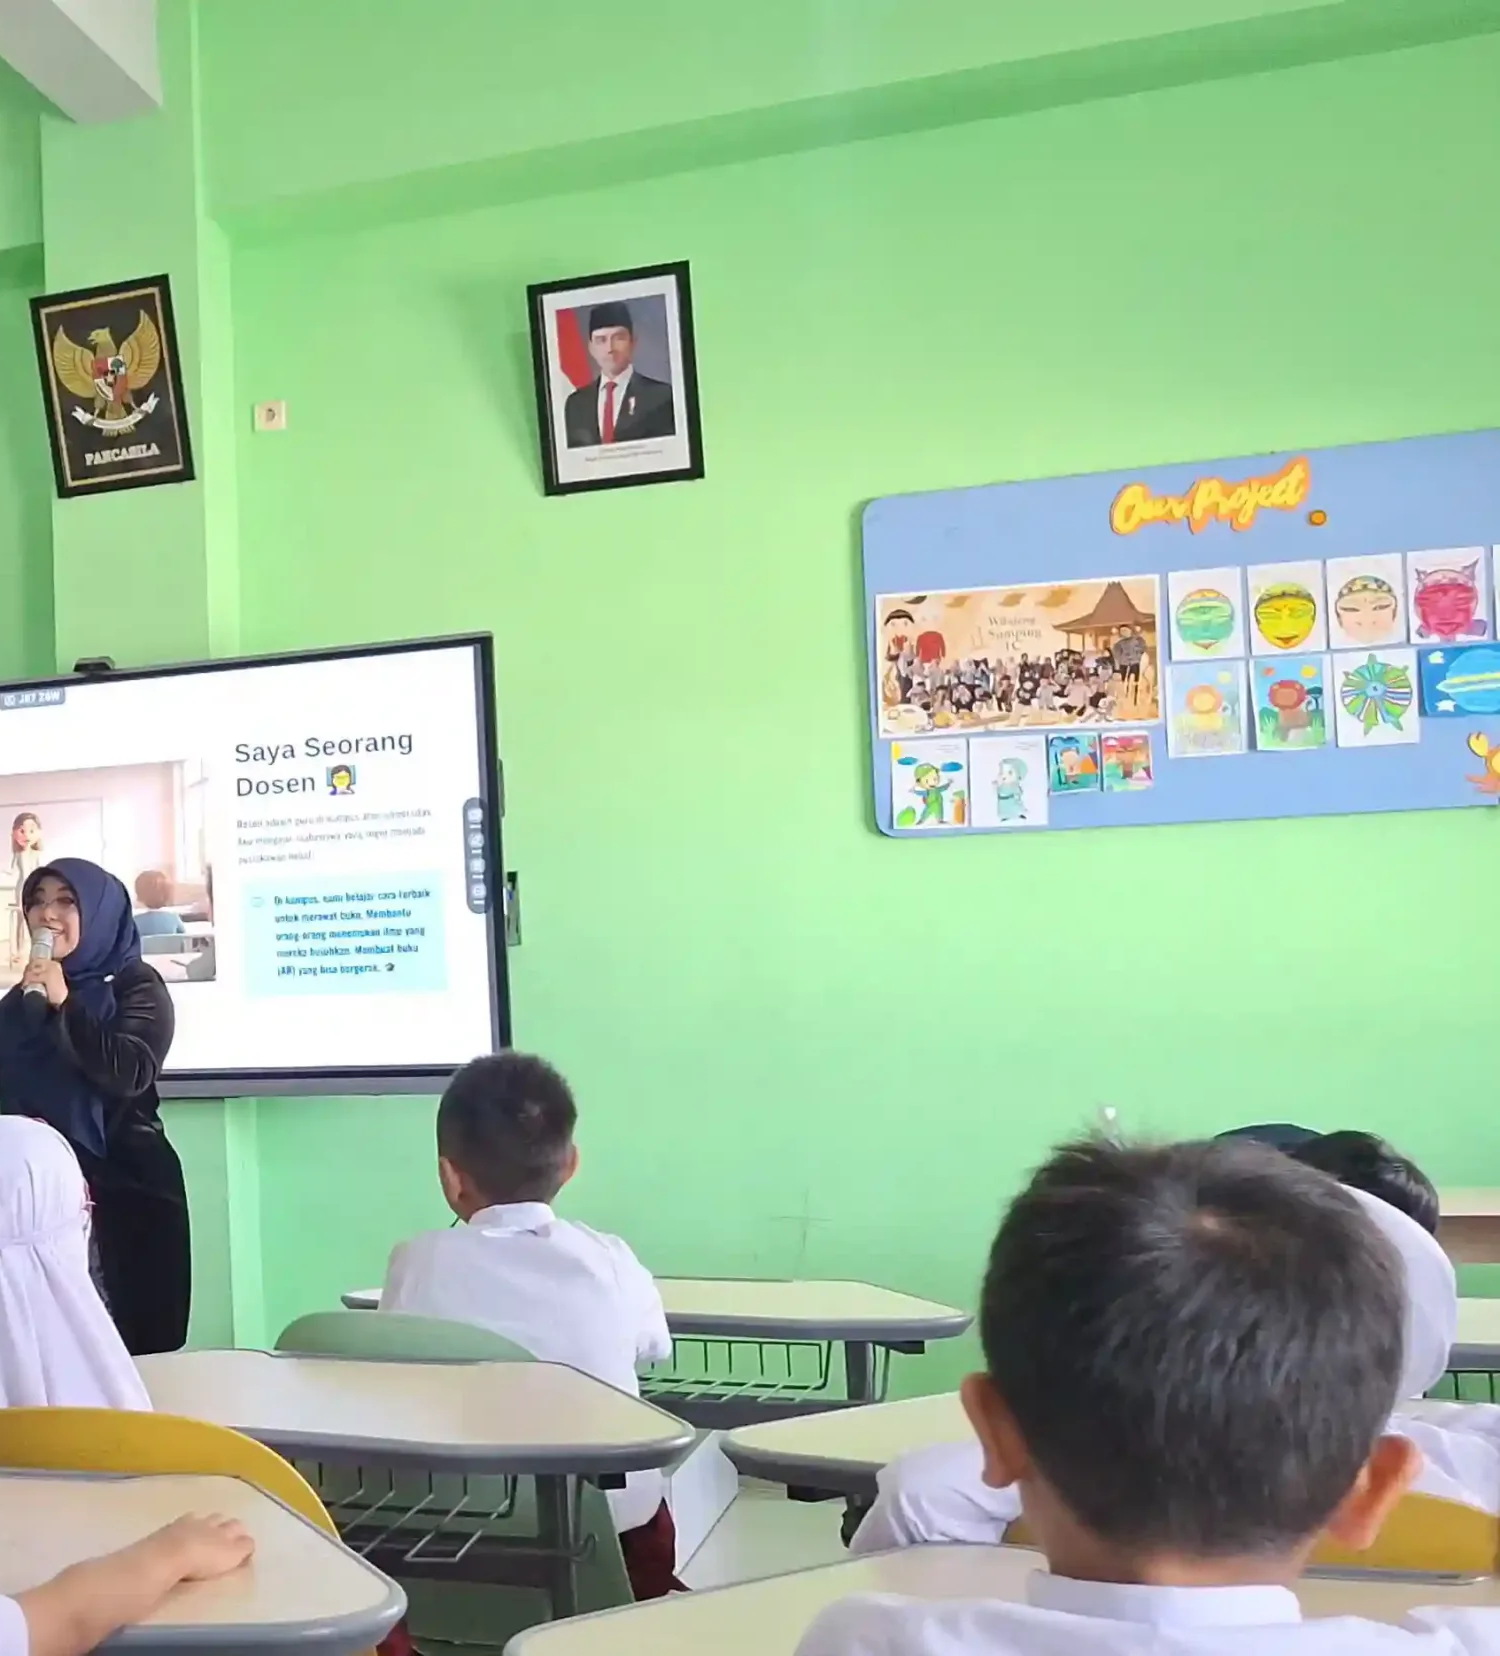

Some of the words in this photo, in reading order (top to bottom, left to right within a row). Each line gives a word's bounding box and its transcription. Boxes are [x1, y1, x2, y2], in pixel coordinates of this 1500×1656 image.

[85, 443, 160, 466] PANCASILA
[1111, 482, 1189, 534] Our
[1189, 458, 1310, 532] Project
[235, 743, 296, 766] Saya
[304, 733, 413, 757] Seorang
[236, 776, 316, 797] Dosen
